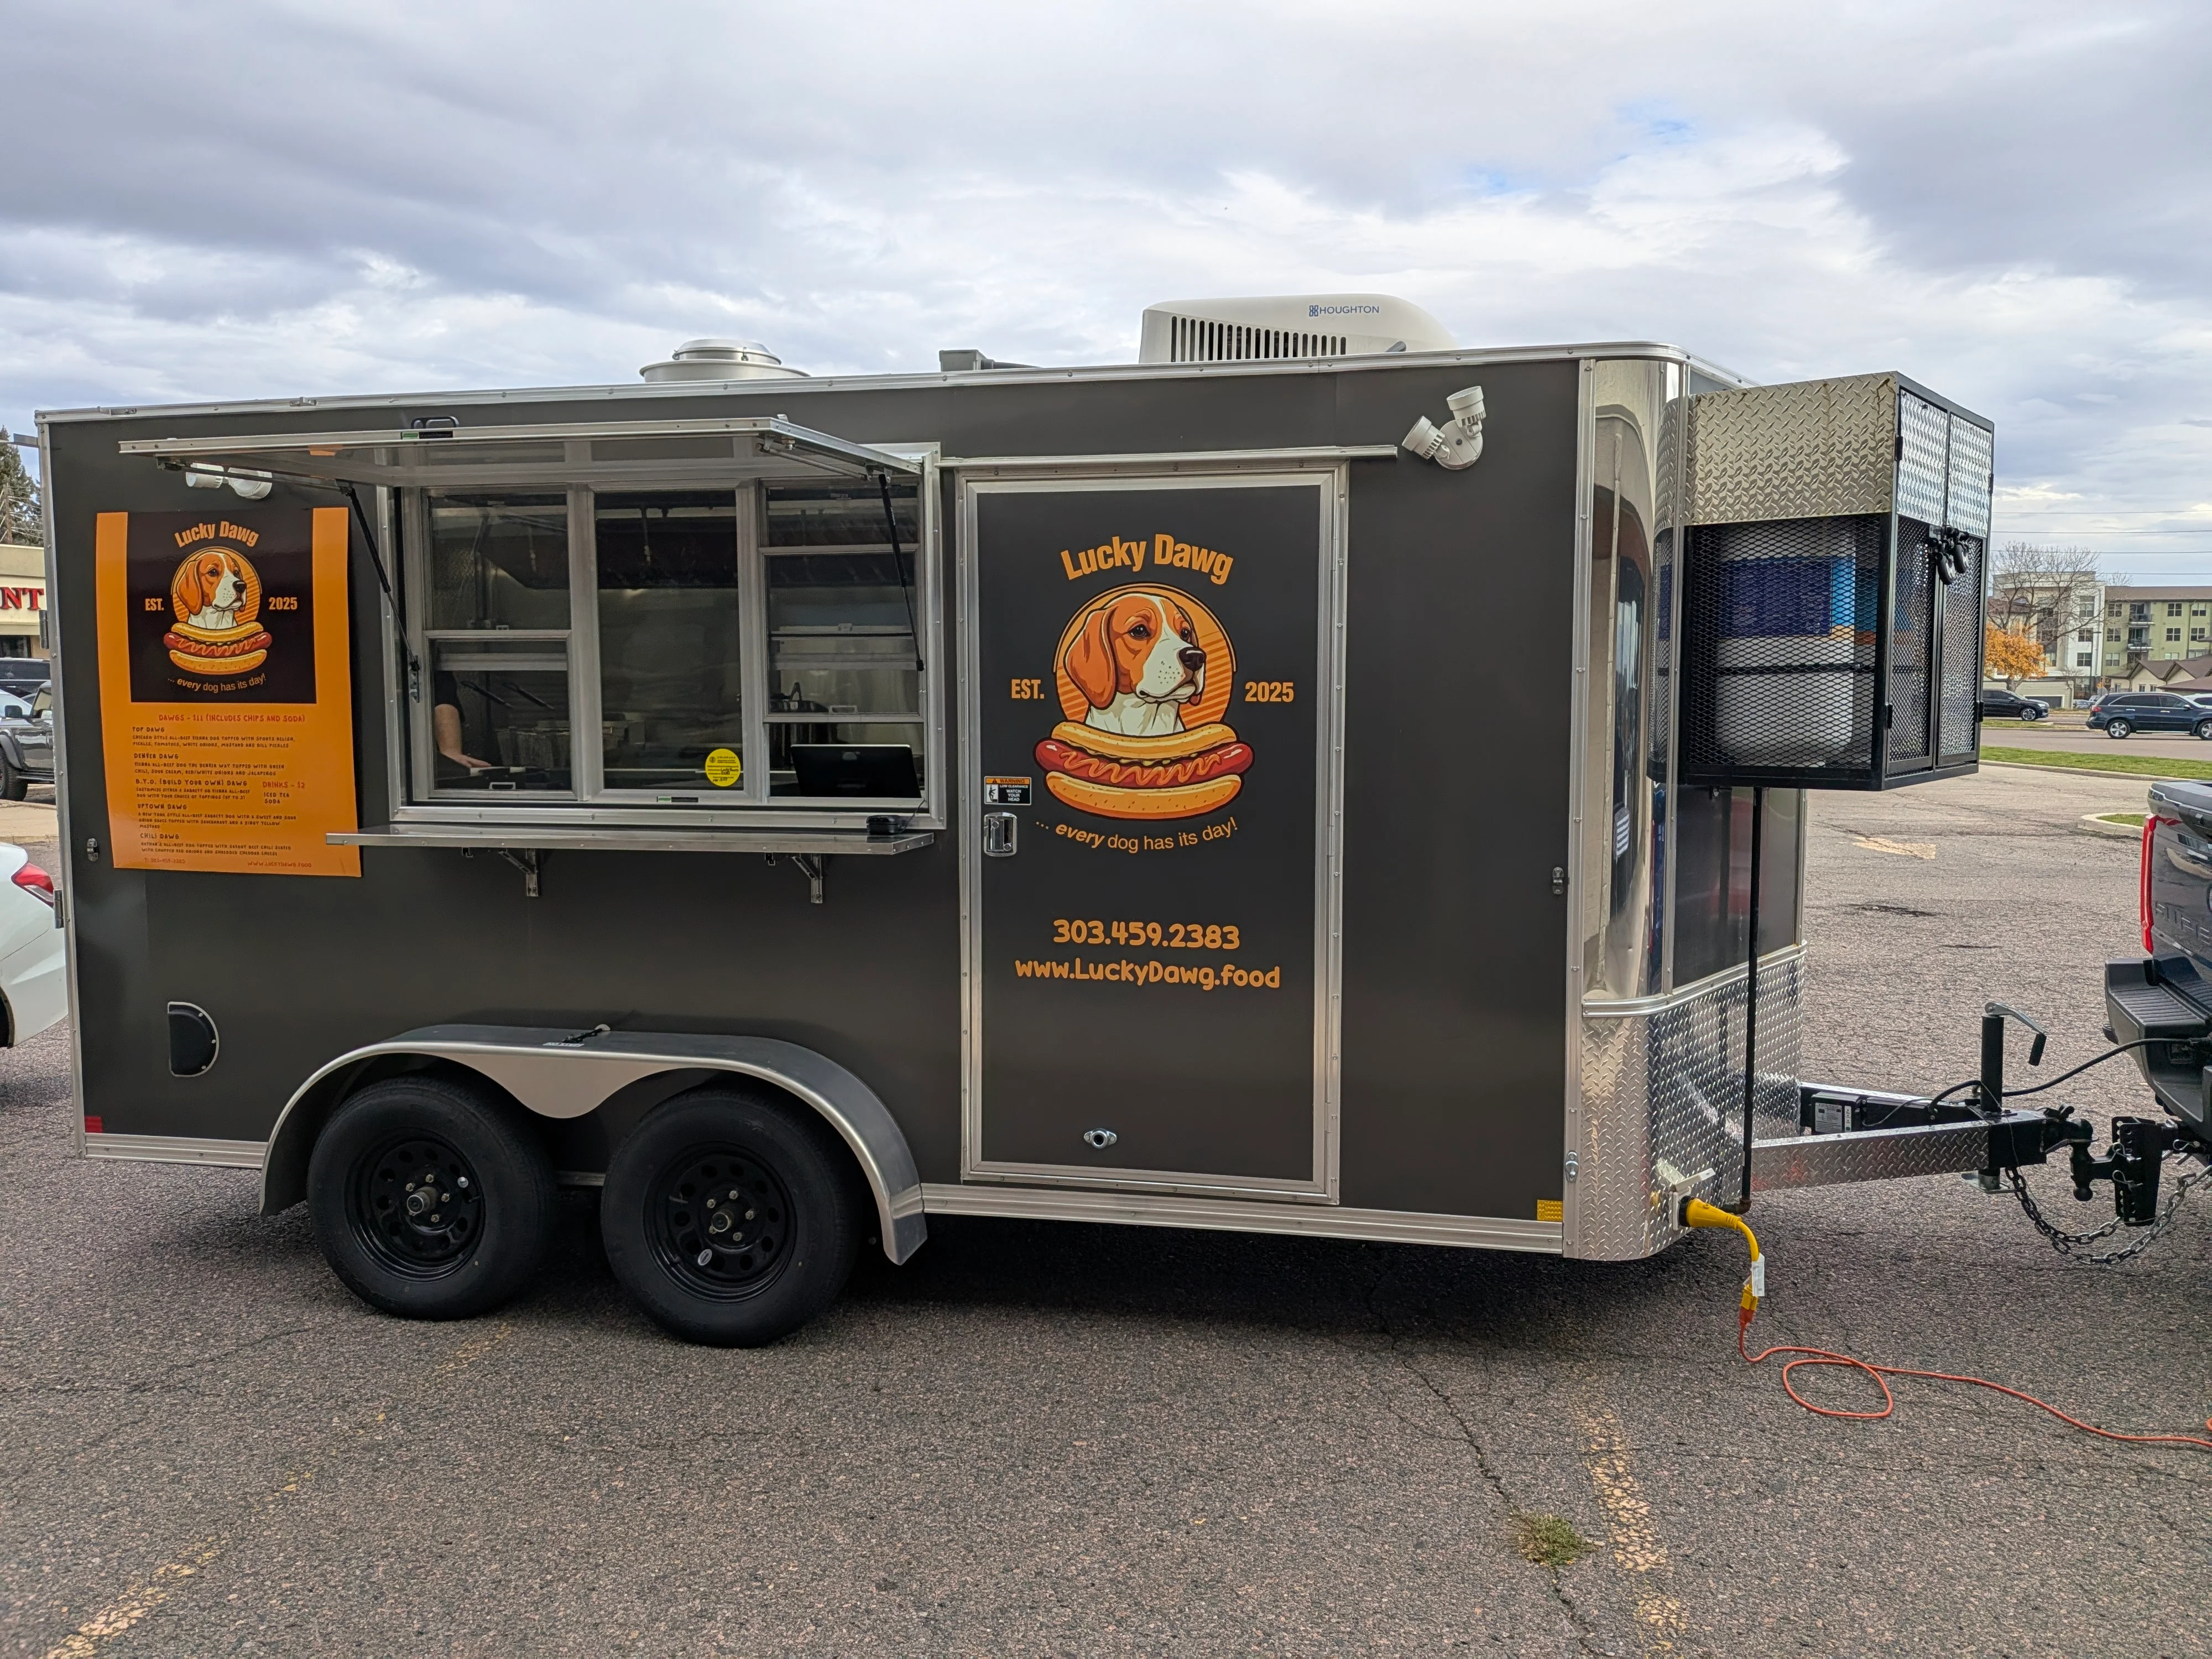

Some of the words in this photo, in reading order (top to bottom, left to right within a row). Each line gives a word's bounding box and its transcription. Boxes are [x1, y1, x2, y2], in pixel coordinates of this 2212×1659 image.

[1319, 305, 1380, 314] HOUGHTON
[174, 523, 215, 547] Lucky
[220, 521, 259, 547] Dawg
[1061, 536, 1147, 580] Lucky
[1155, 534, 1234, 586] Dawg
[145, 598, 164, 611] EST.
[269, 597, 298, 611] 2025
[177, 678, 201, 691] every
[203, 683, 218, 693] dog
[221, 682, 236, 691] has
[237, 681, 248, 689] its
[249, 673, 266, 686] day!
[1011, 679, 1045, 700] EST.
[1245, 681, 1294, 702] 2025
[1055, 824, 1105, 849] every
[1108, 834, 1138, 854] dog
[1144, 836, 1174, 850] has
[1178, 832, 1198, 847] its
[1202, 816, 1238, 841] day!
[1052, 919, 1240, 950] 303.459.2383
[1015, 957, 1280, 991] www.LuckyDawg.food
